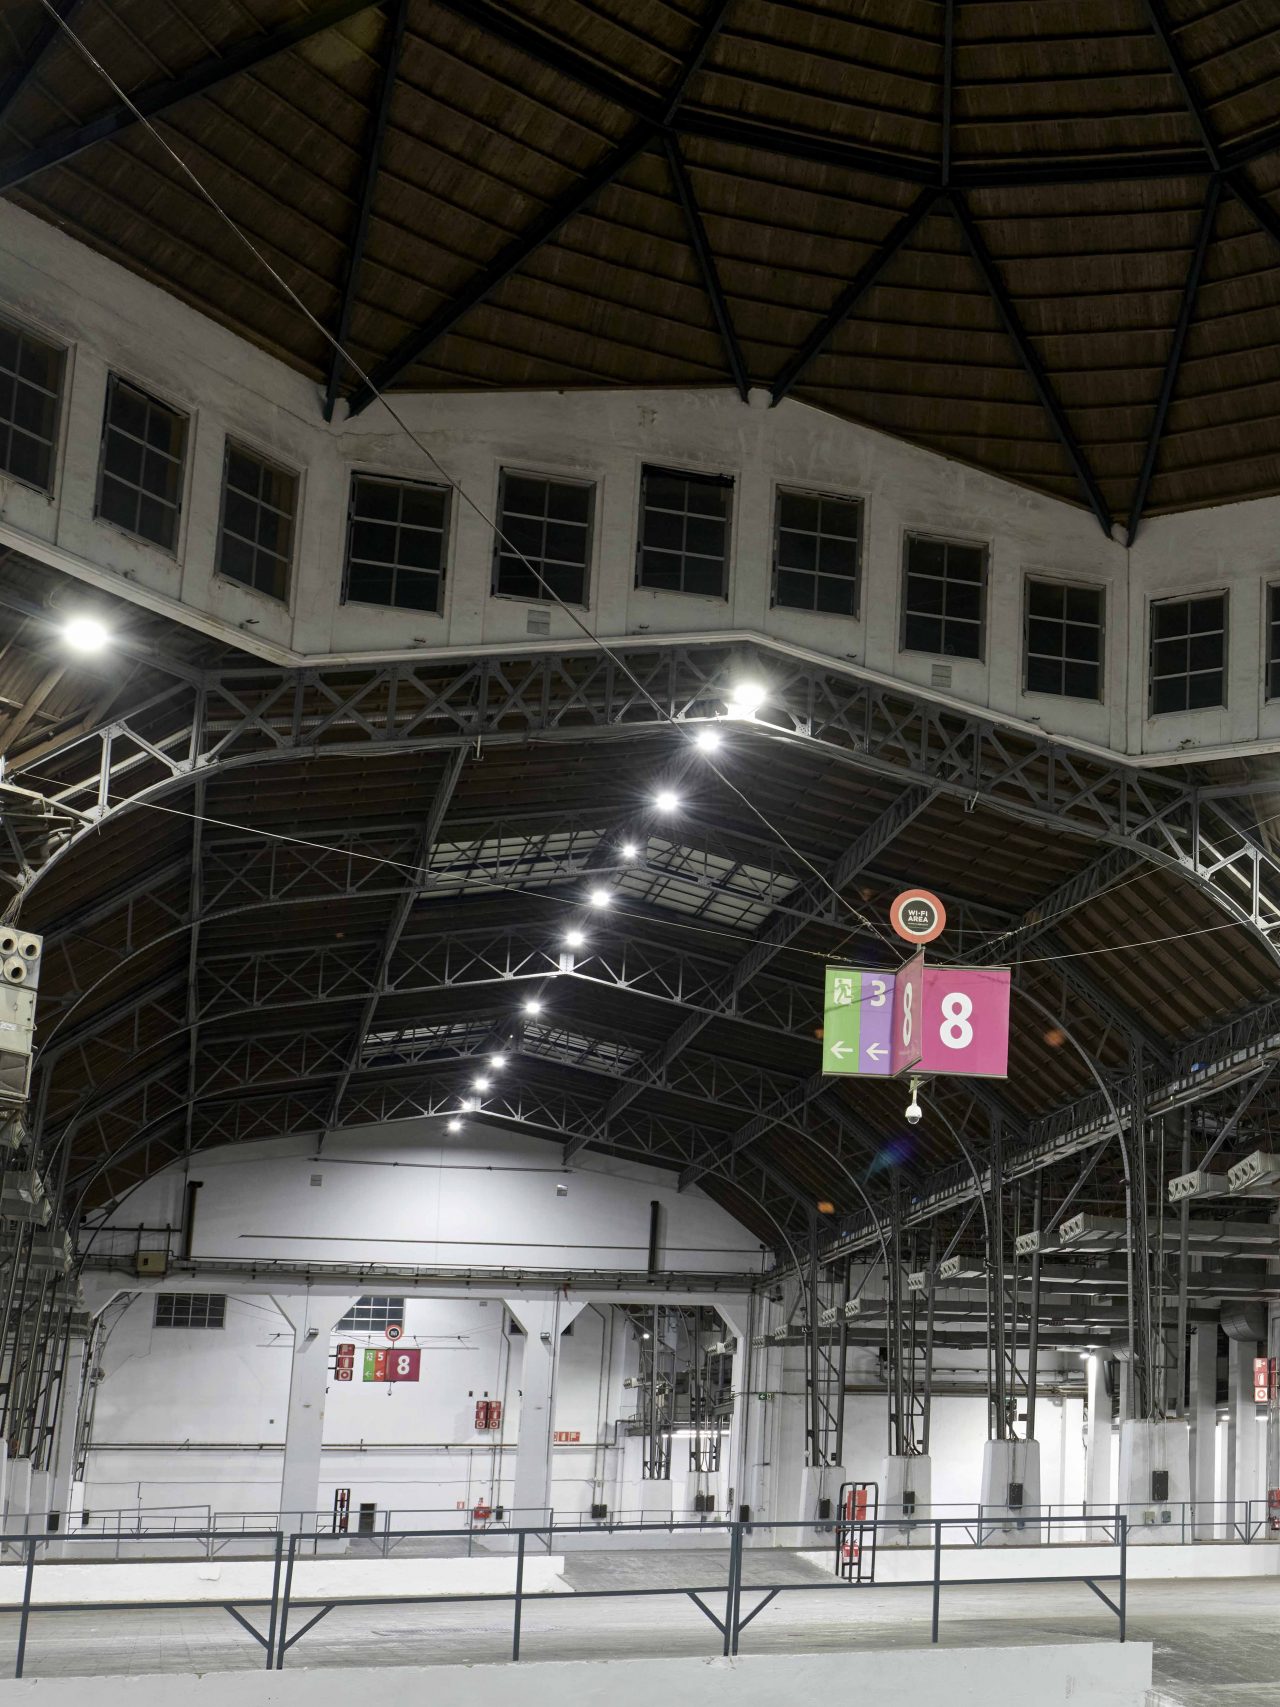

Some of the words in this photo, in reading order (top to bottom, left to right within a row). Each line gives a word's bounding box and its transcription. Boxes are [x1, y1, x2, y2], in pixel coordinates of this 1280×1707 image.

[908, 909, 928, 917] WI-FI
[908, 915, 929, 923] AREA
[870, 980, 886, 1007] 3
[903, 982, 912, 1047] 8
[940, 992, 973, 1049] 8
[377, 1352, 384, 1361] 5
[397, 1355, 410, 1375] 8
